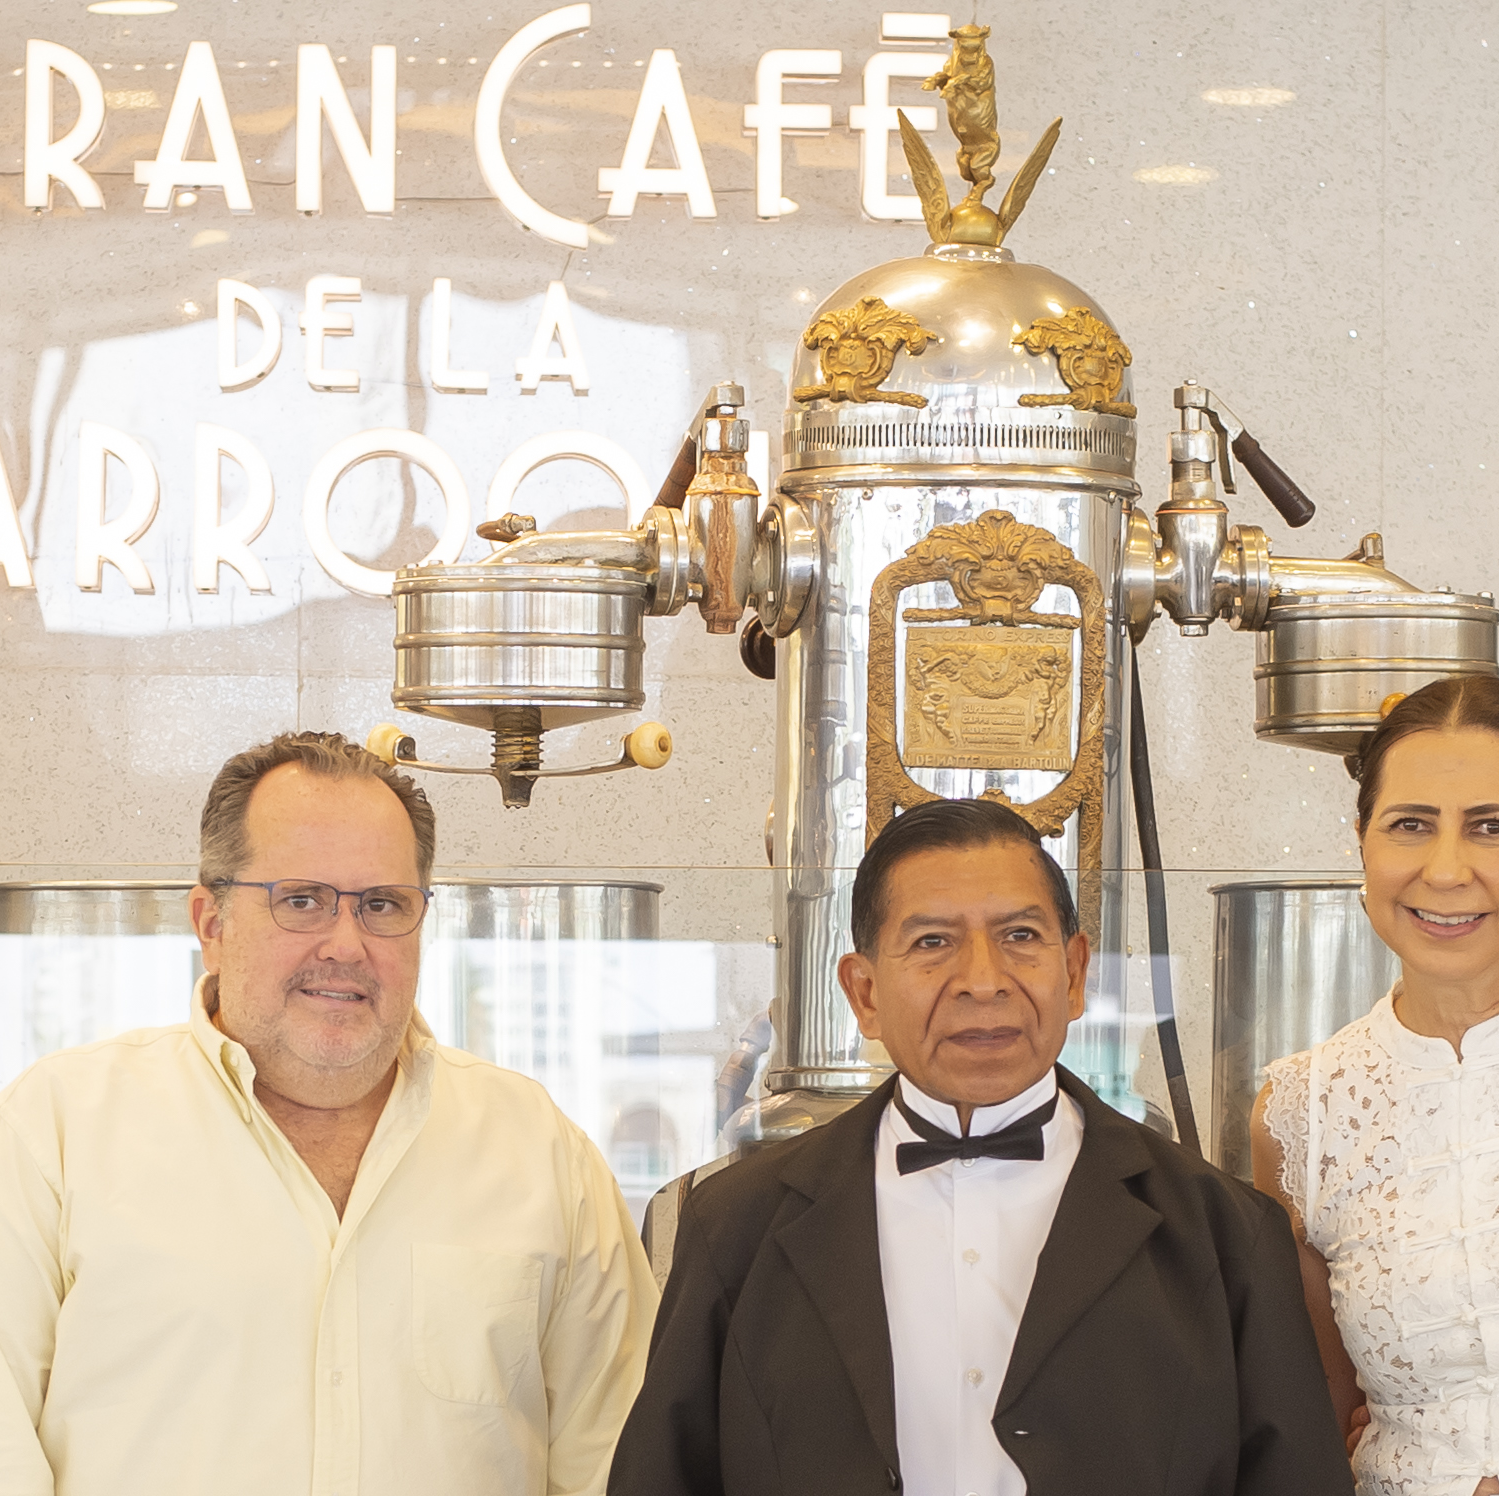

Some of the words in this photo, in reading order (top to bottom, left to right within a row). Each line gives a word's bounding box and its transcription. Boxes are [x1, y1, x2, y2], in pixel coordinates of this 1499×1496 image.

[474, 2, 951, 248] CAFÉ
[217, 277, 362, 393] DE
[429, 276, 590, 395] LA
